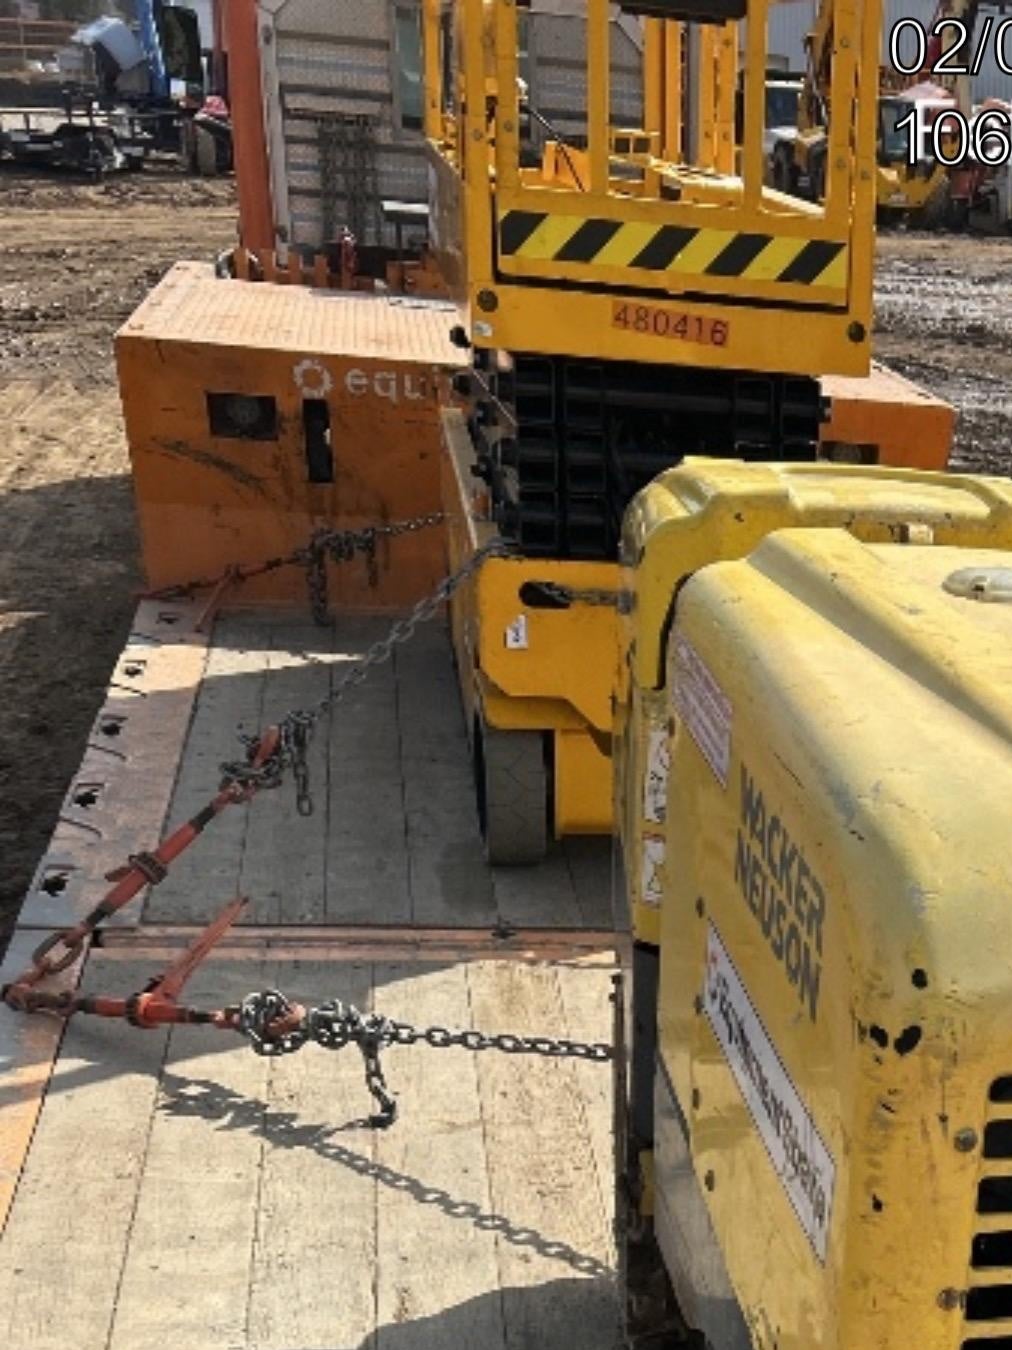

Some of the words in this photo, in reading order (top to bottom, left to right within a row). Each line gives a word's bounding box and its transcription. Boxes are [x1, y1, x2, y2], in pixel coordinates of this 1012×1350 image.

[614, 304, 727, 346] 480416
[735, 828, 822, 1024] NEUSON
[741, 760, 826, 957] WACKER
